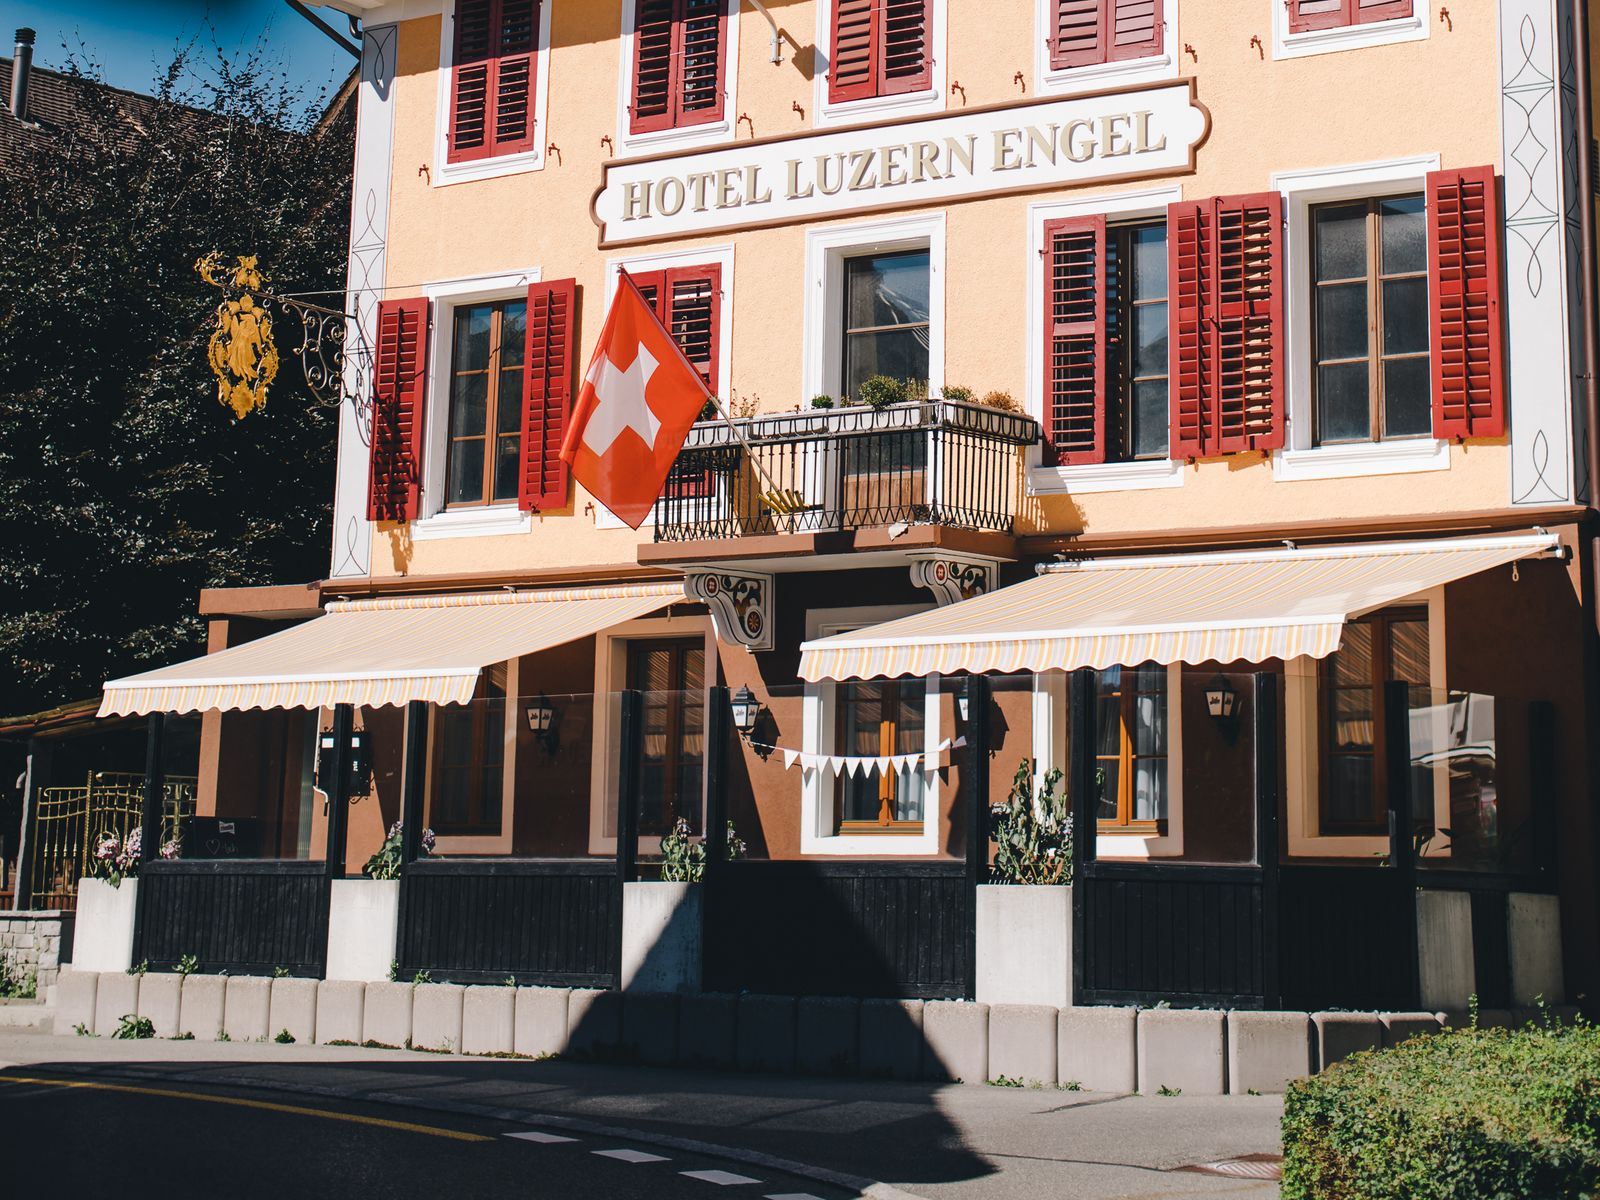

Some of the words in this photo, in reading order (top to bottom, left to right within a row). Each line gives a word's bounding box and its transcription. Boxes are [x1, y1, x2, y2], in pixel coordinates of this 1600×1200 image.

[620, 164, 772, 222] HOTEL
[784, 133, 979, 201] LUZERN
[990, 109, 1168, 172] ENGEL
